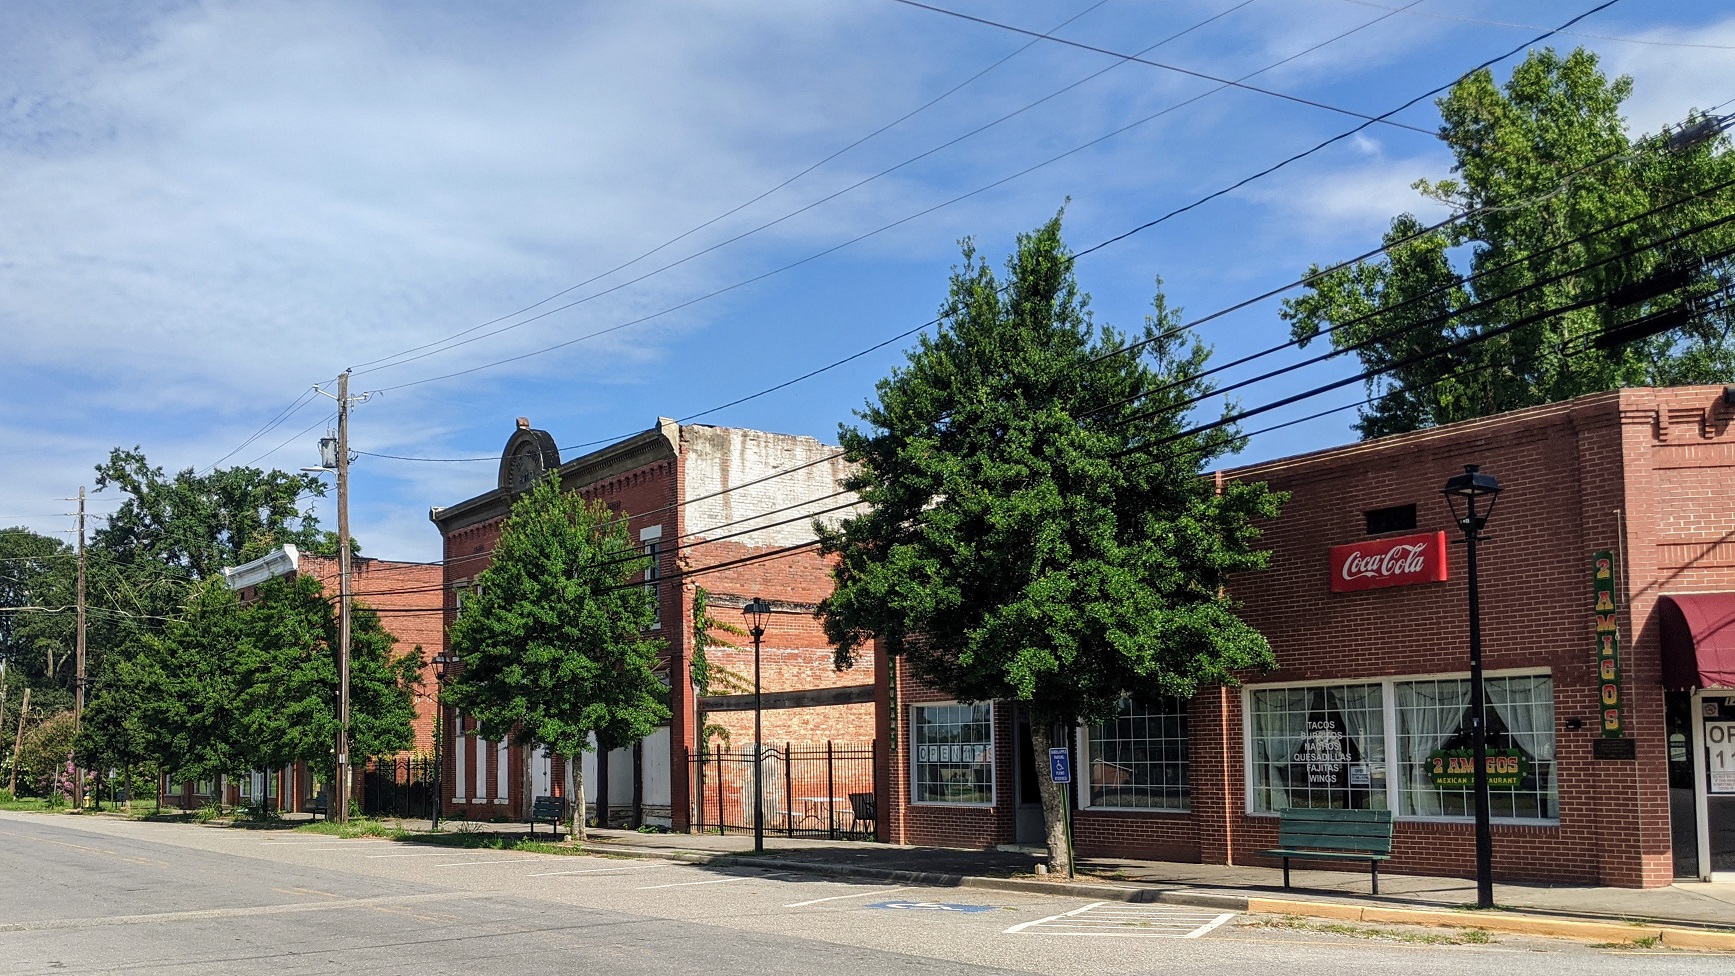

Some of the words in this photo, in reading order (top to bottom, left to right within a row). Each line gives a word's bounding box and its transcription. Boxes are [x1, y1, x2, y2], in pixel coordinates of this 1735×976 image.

[1342, 543, 1428, 580] Coca-Cola
[1596, 558, 1610, 579] 2
[1595, 590, 1619, 730] AMIGOS
[1307, 721, 1335, 730] TACOS
[1300, 731, 1343, 740] BURRITOS
[1304, 741, 1340, 751] NACHOS
[920, 748, 959, 760] OPEN
[1293, 752, 1352, 762] QUESADILLAS
[1306, 763, 1339, 772] FAJITAS
[1433, 757, 1443, 774] 2
[1447, 756, 1519, 774] AMGOS
[1309, 774, 1337, 783] WINGS
